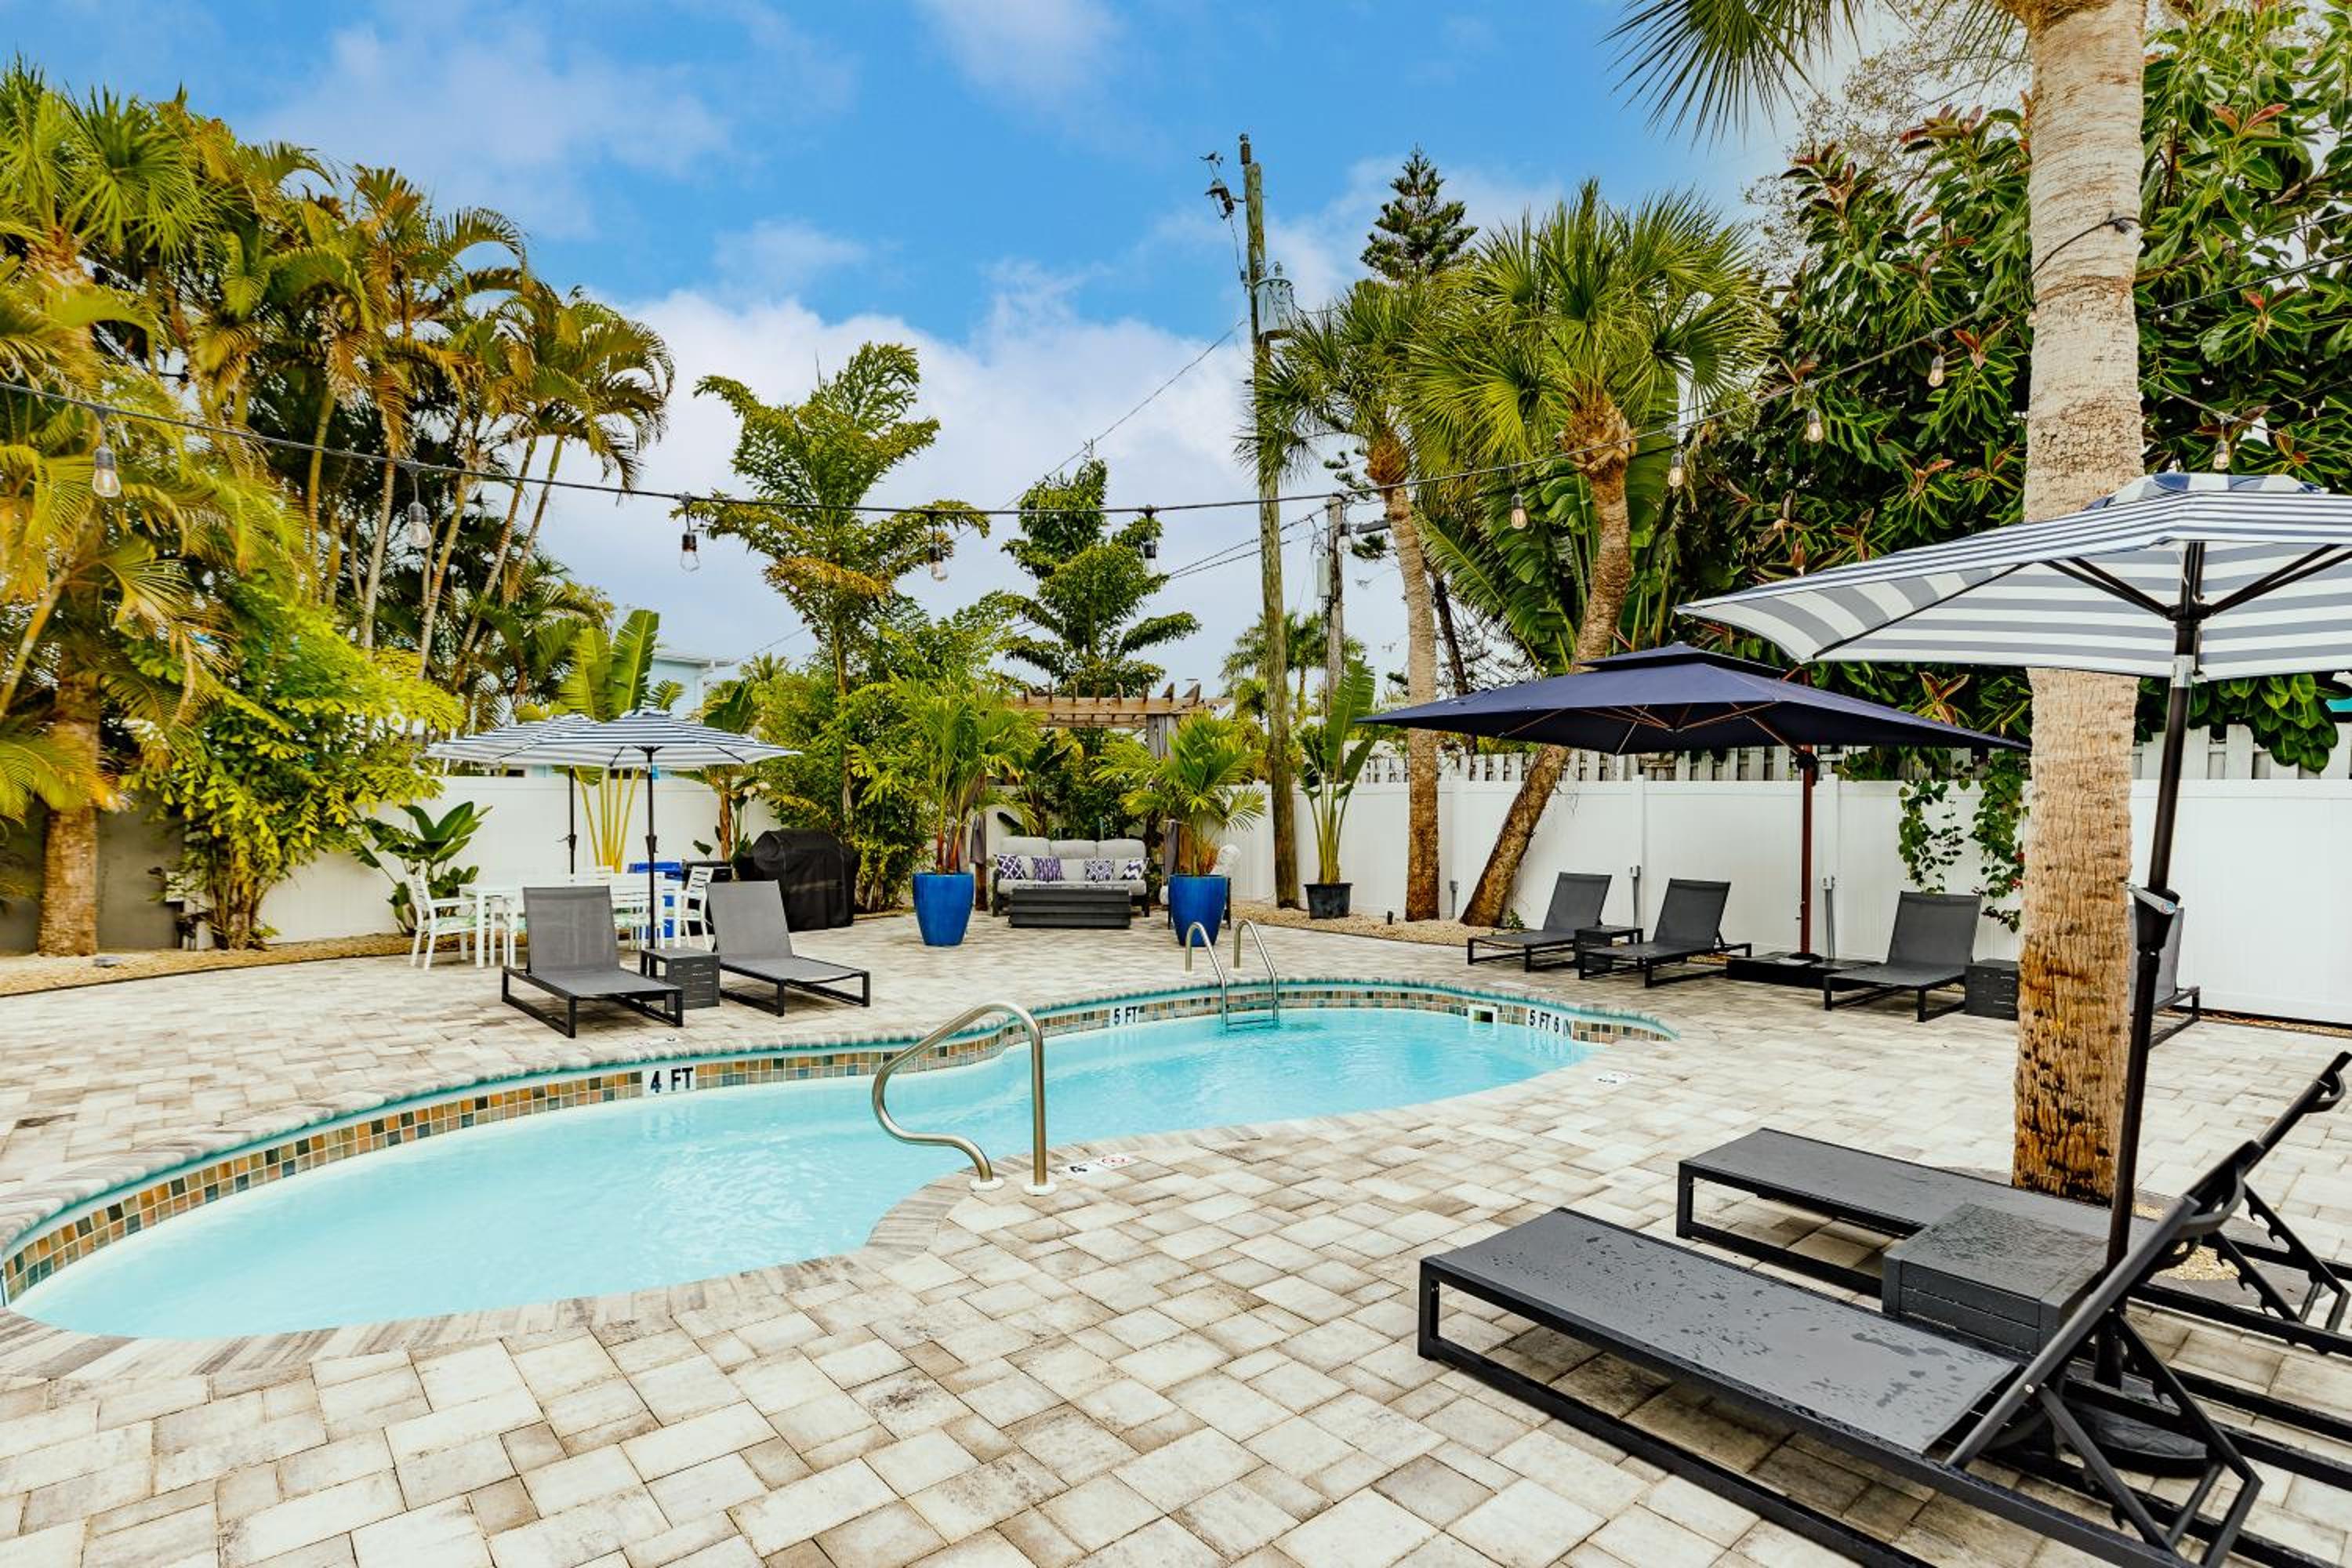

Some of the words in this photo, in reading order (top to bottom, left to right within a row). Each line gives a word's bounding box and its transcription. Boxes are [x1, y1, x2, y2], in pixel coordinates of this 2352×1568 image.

[1114, 1007, 1120, 1025] 5
[1125, 1007, 1138, 1023] FT
[1530, 1009, 1536, 1026] 5
[1539, 1011, 1551, 1030] FT
[1553, 1017, 1559, 1033] 6
[1563, 1020, 1572, 1037] IN
[650, 1070, 662, 1093] 4
[671, 1066, 694, 1091] FT
